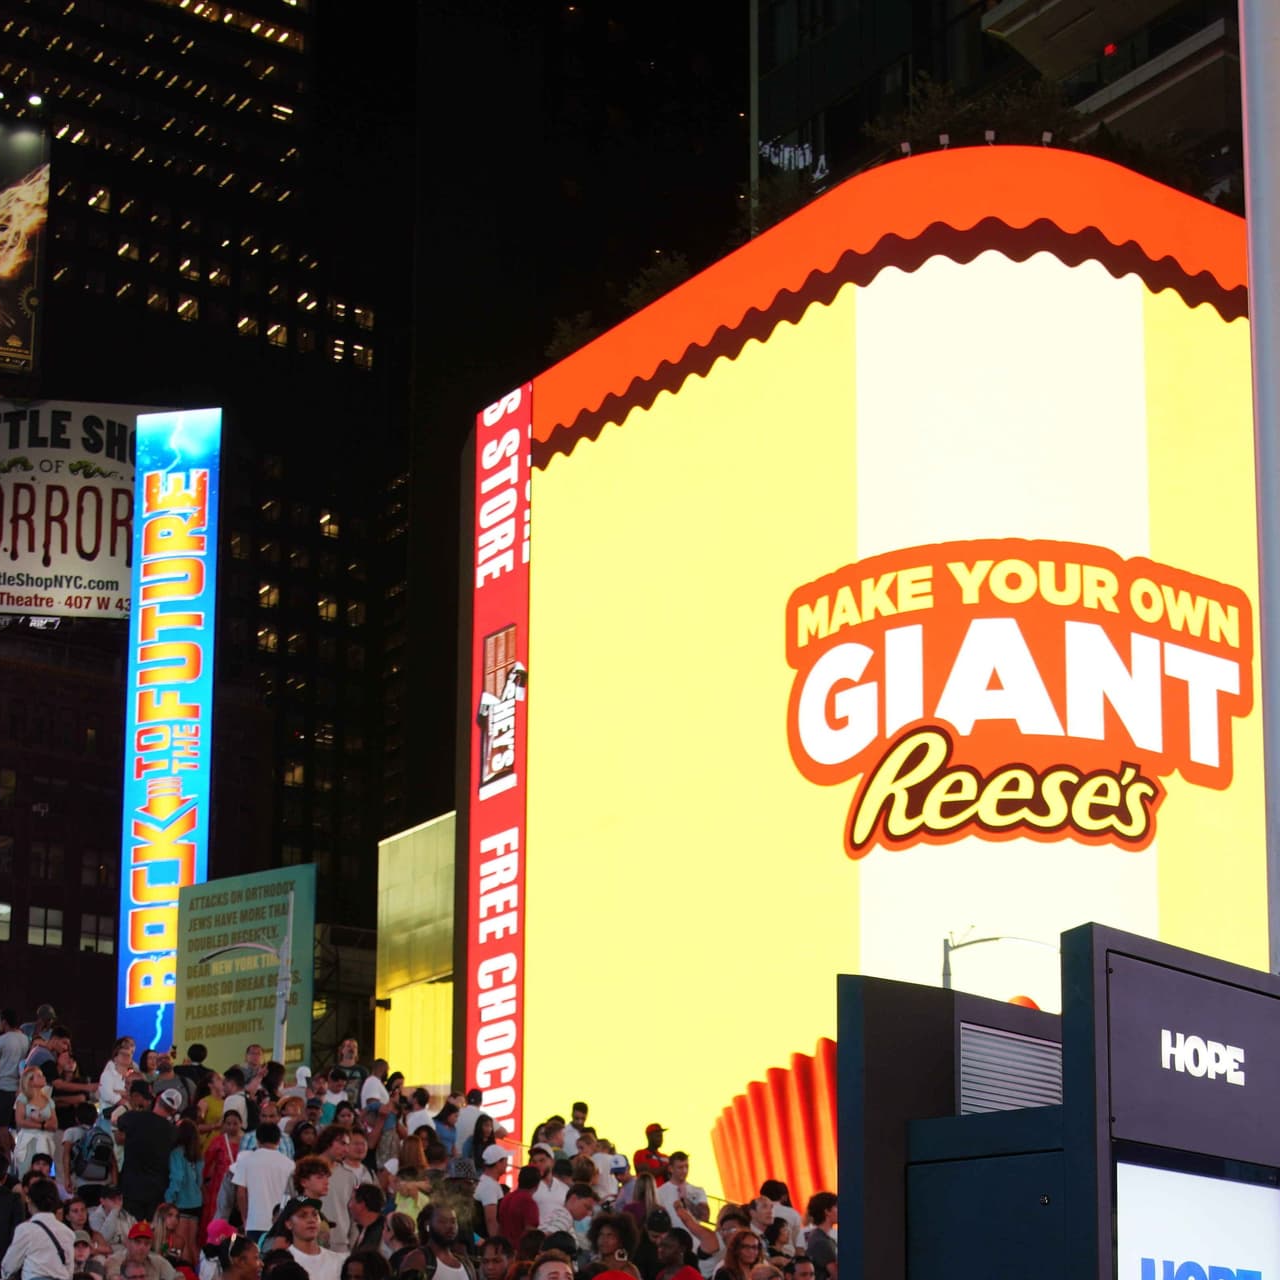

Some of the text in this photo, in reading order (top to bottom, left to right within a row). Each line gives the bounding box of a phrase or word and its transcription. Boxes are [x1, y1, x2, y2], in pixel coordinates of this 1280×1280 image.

[81, 415, 136, 464] SH
[39, 459, 65, 473] OF
[476, 428, 521, 589] STORE
[65, 595, 92, 609] 407
[97, 596, 111, 610] W
[797, 559, 1240, 648] MAKE YOUR OWN
[798, 617, 1240, 768] GIANT
[125, 468, 209, 1008] BACK TO THE FUTURE
[850, 730, 1158, 848] Reese's
[479, 826, 518, 944] FREE
[189, 890, 230, 912] ATTACKS
[232, 888, 243, 905] ON
[188, 915, 213, 932] JEWS
[214, 911, 238, 928] HAVE
[239, 907, 267, 925] MORE
[188, 933, 230, 953] DOUBLED
[187, 964, 211, 980] DEAR
[211, 960, 233, 976] NEW
[234, 956, 258, 973] YORK
[235, 974, 266, 993] BREAK
[185, 1001, 220, 1020] PLEASE
[221, 998, 245, 1016] STOP
[185, 1018, 265, 1042] OUR COMMUNITY.
[1161, 1028, 1246, 1087] HOPE
